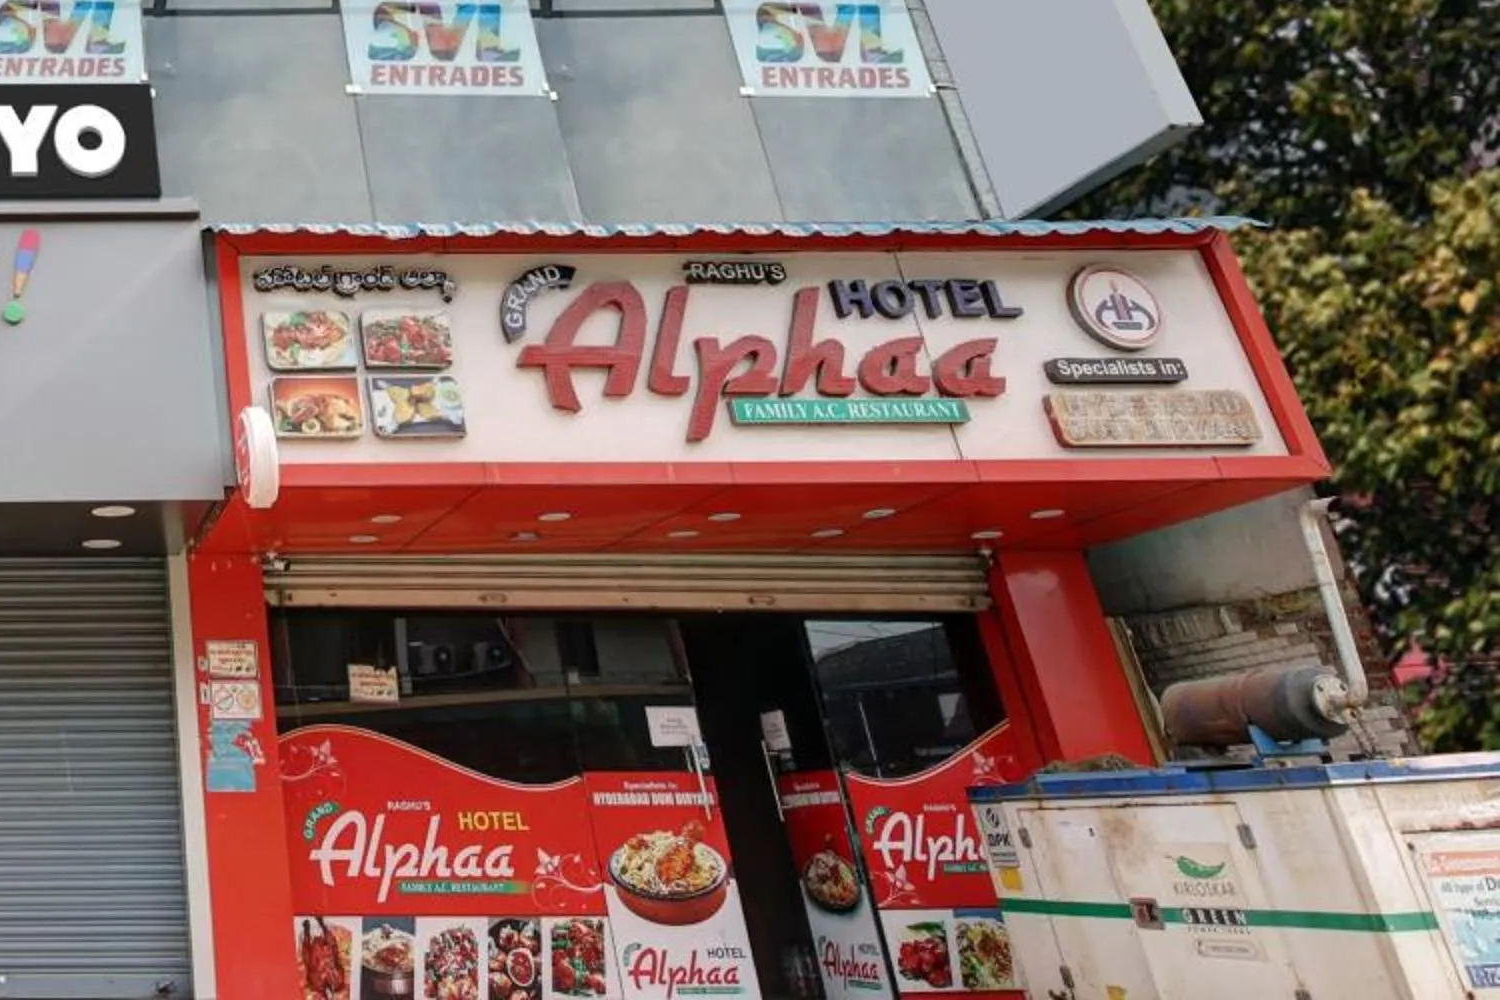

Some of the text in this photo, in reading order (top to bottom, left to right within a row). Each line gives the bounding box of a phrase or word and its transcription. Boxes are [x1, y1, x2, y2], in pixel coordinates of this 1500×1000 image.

[367, 2, 521, 61] SVL
[755, 2, 904, 62] SVL
[370, 64, 524, 88] ENTRADES
[761, 66, 910, 90] ENTRADES
[690, 262, 786, 281] RAGHU'S
[505, 265, 562, 329] GRAND
[829, 278, 1023, 320] HOTEL
[516, 280, 1006, 443] Alphaa
[1056, 359, 1184, 380] Specialists in:
[744, 401, 960, 419] FAMILY A.C. RESTAURANT
[458, 811, 530, 831] HOTEL
[309, 810, 514, 903] Alphaa
[707, 948, 747, 959] HOTEL
[628, 948, 740, 1000] Alphaa
